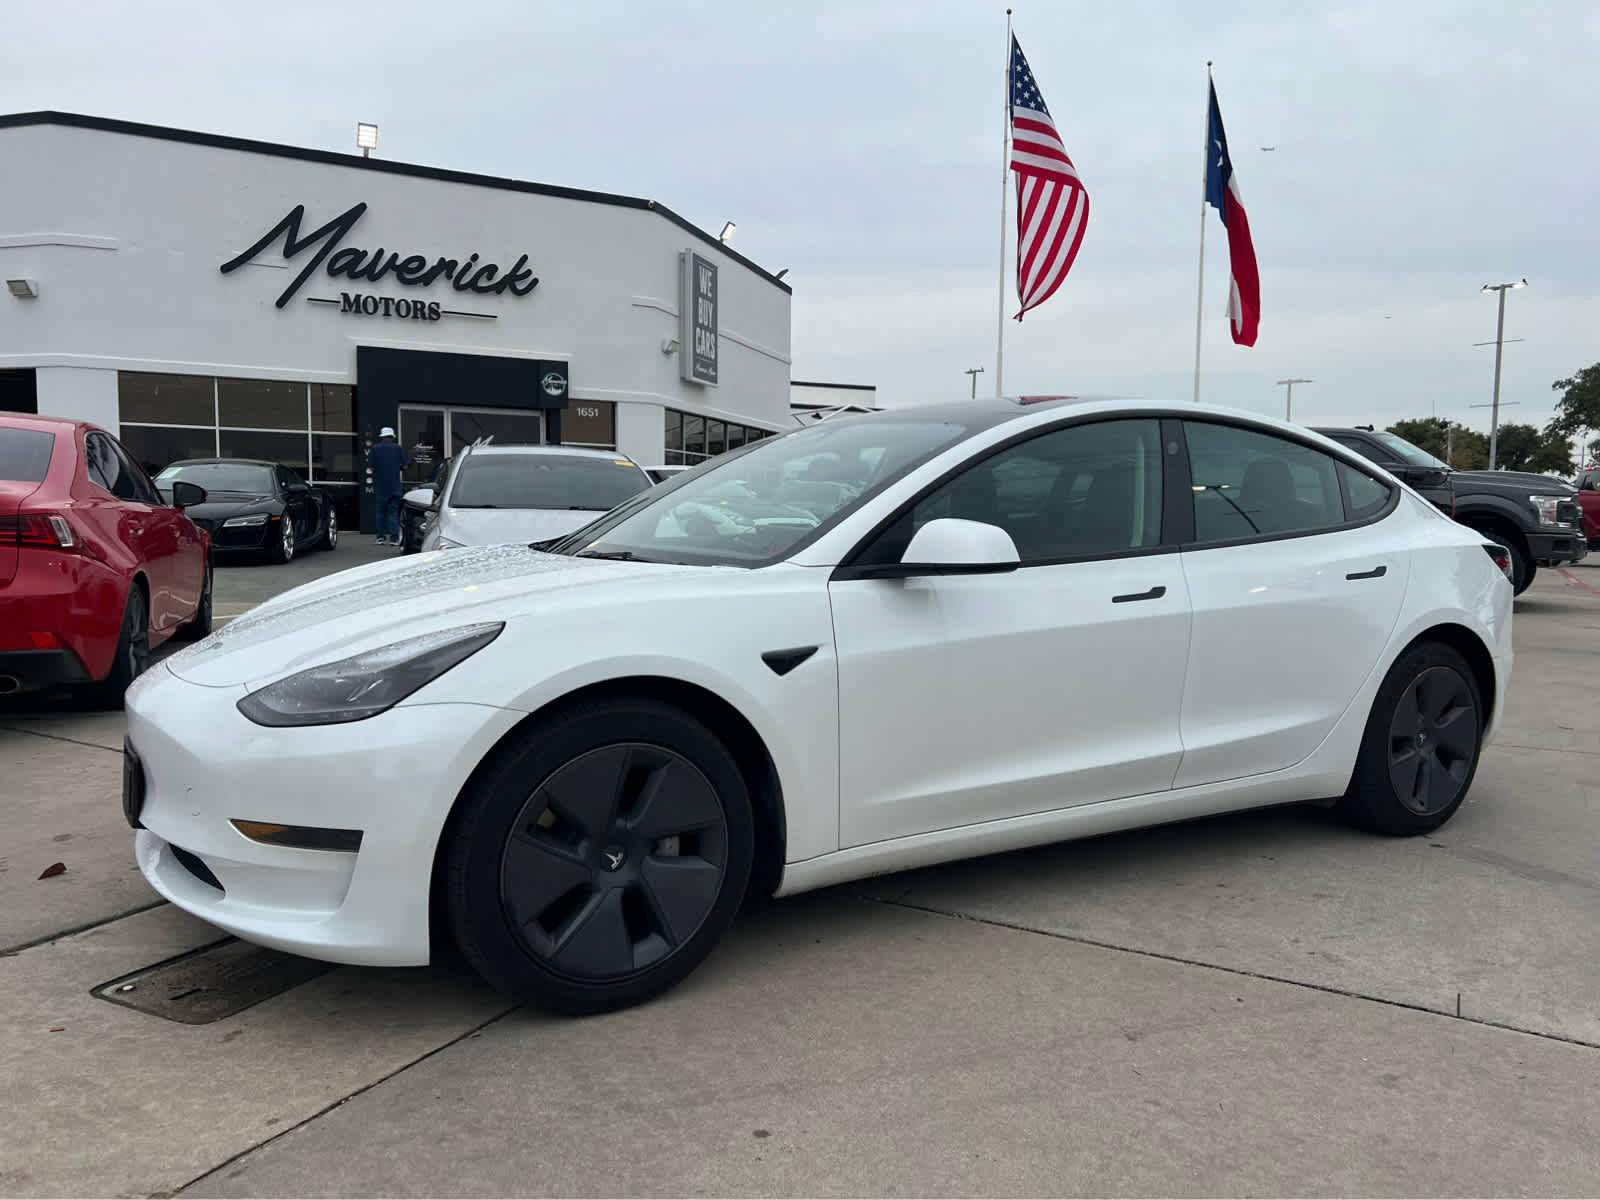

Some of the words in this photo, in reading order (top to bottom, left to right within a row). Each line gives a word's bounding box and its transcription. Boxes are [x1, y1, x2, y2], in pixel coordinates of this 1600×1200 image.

[220, 202, 539, 309] Maverick
[699, 264, 713, 298] WE
[340, 292, 442, 321] MOTORS
[698, 297, 713, 329] BUY
[695, 327, 716, 360] CARS
[576, 407, 599, 417] 1651
